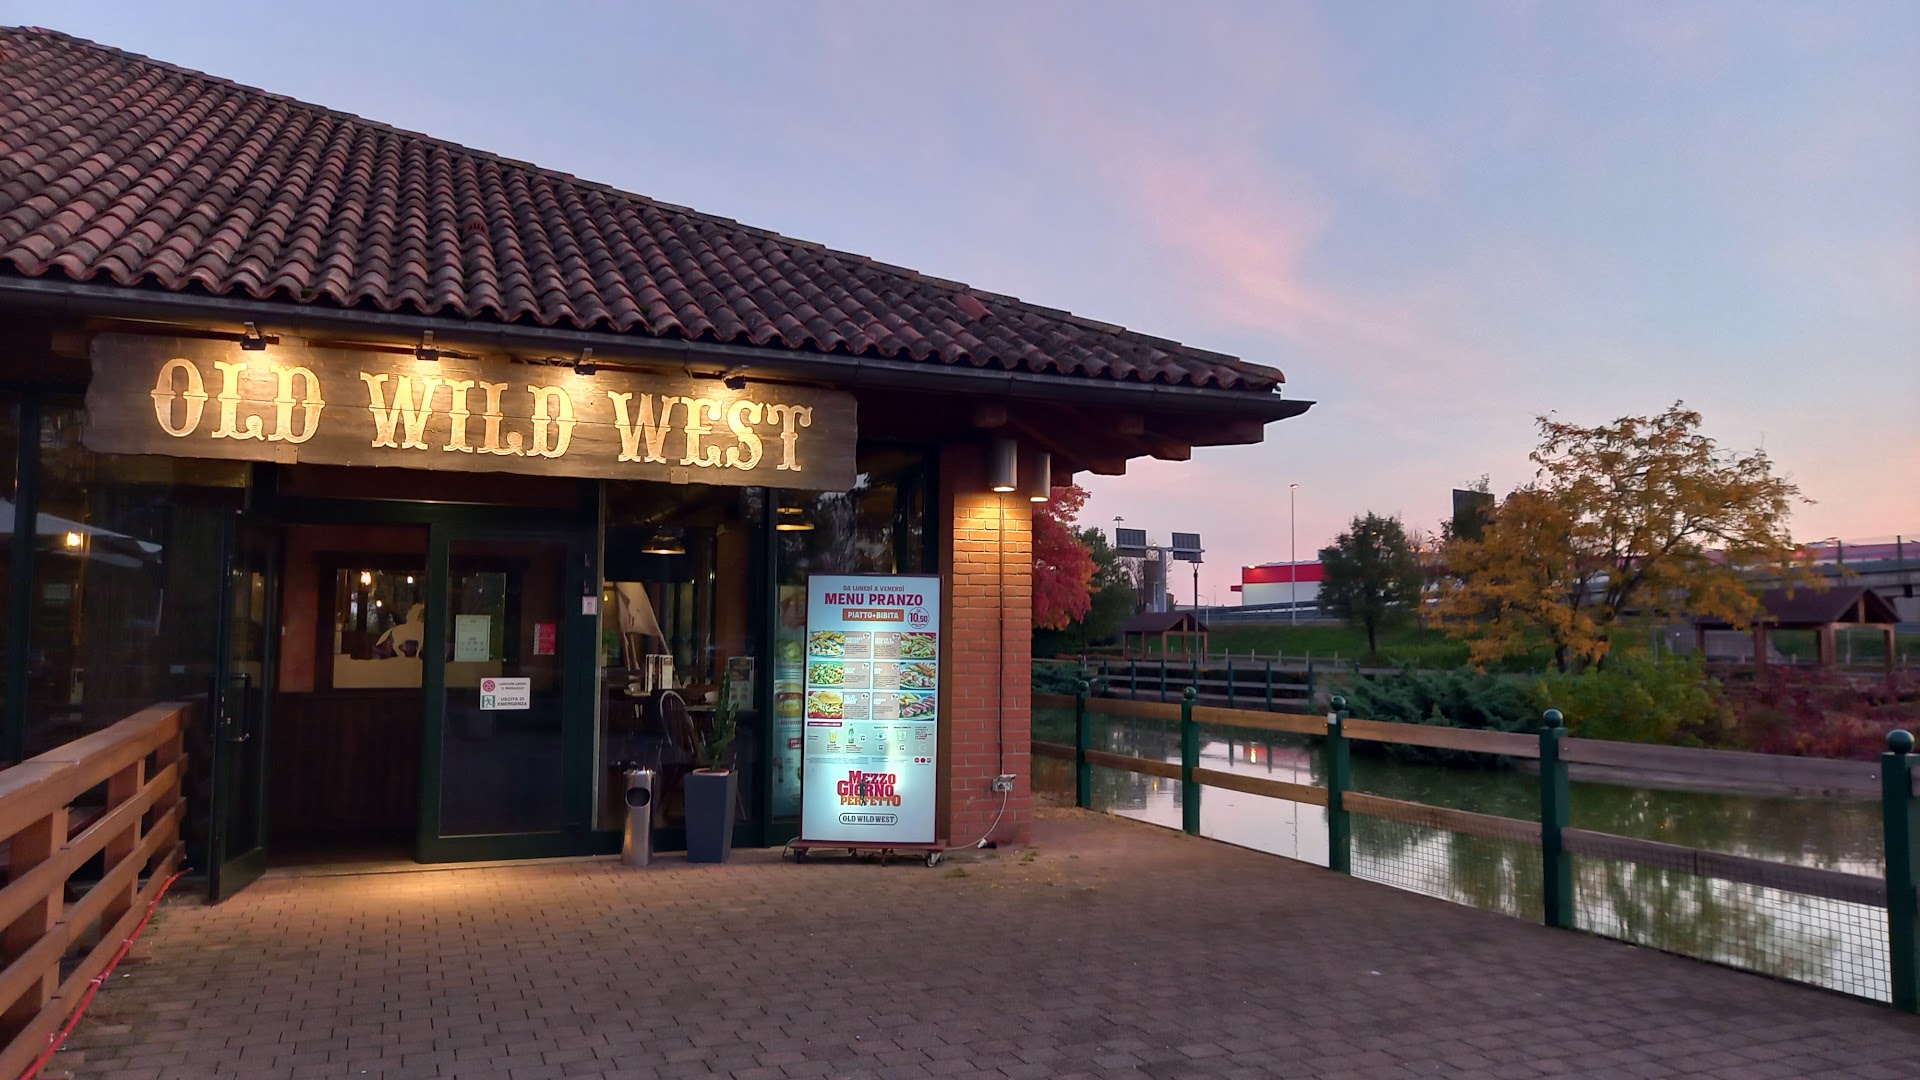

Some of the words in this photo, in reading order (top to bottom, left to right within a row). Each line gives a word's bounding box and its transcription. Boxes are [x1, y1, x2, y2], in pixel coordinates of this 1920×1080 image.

[150, 358, 326, 444] OLD
[359, 371, 577, 460] WILD
[607, 390, 813, 471] WEST
[824, 592, 864, 605] MENU
[868, 593, 923, 606] PRANZO
[847, 611, 899, 619] PIATTO+BIBITA
[909, 612, 928, 623] 10,50
[849, 770, 896, 785] MEZZO
[837, 780, 894, 797] GIORNO
[840, 794, 902, 807] PERFETTO
[842, 815, 856, 823] OLD
[857, 815, 875, 823] WILD
